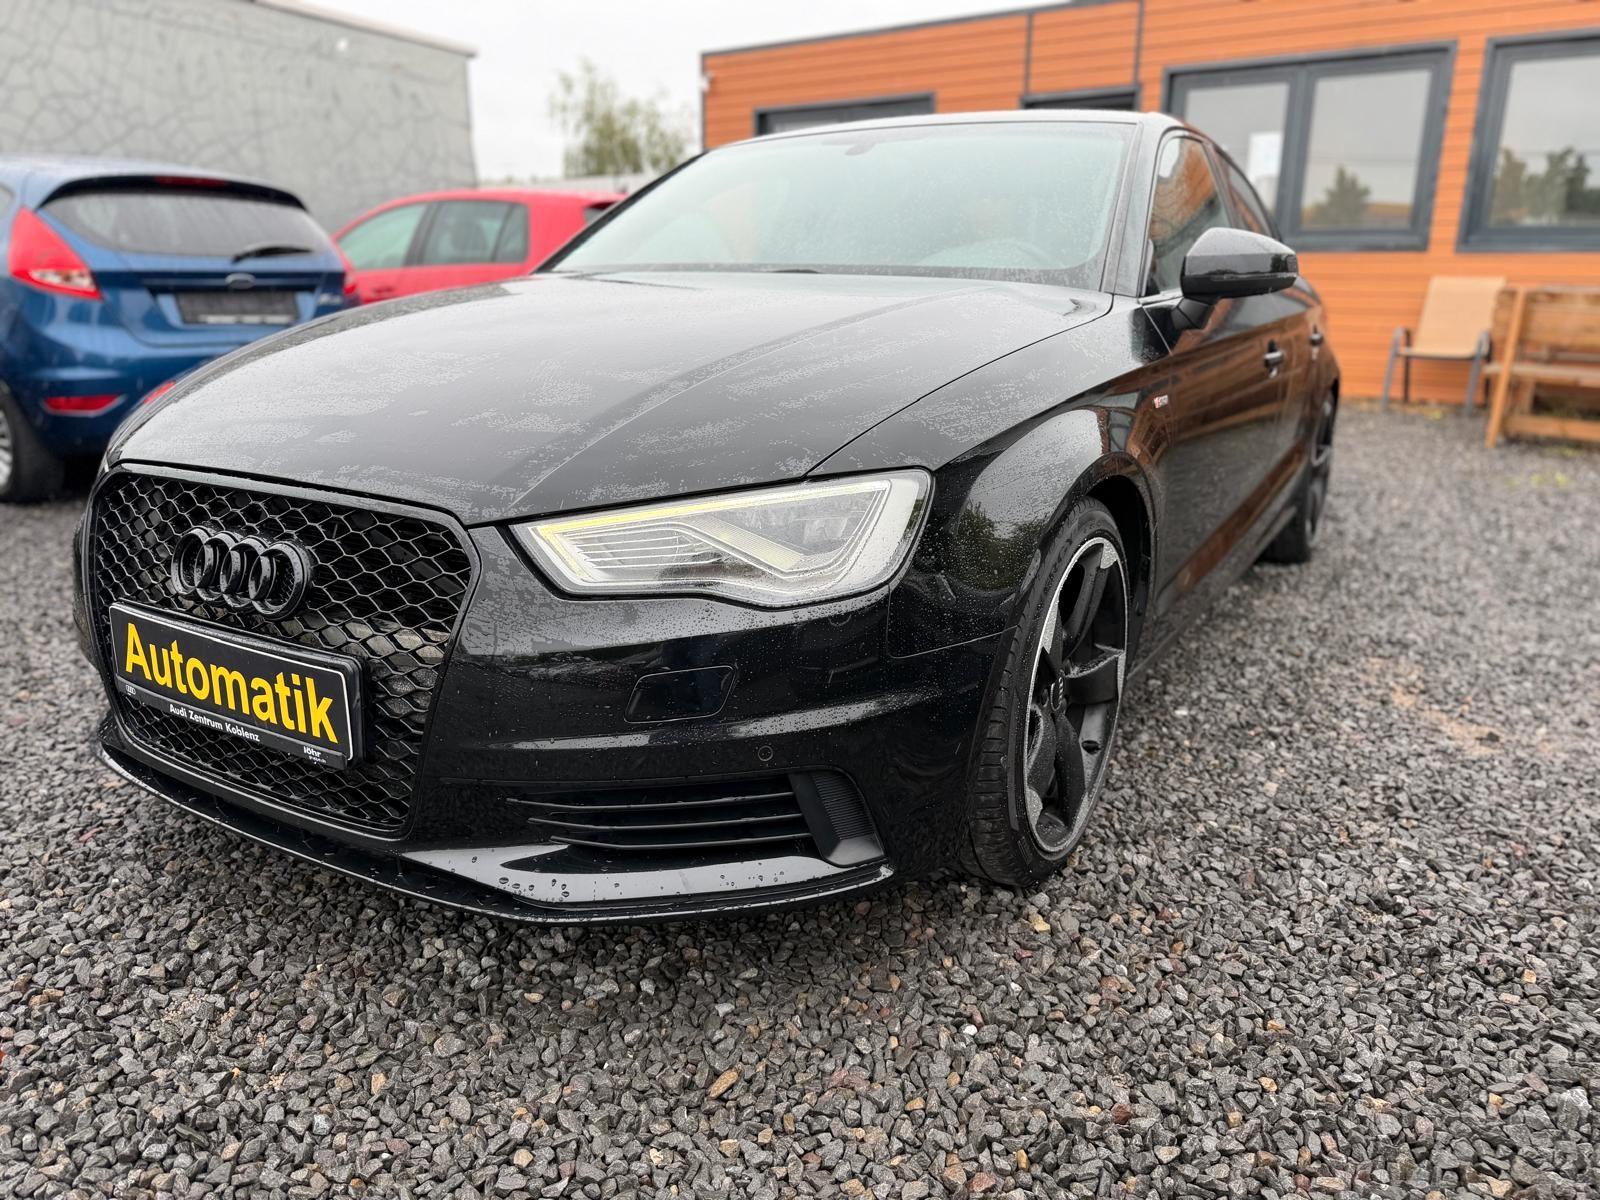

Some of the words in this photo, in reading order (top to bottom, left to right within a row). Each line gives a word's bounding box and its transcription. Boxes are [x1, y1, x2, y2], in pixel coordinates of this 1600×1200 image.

[125, 622, 338, 743] Automatik
[169, 703, 187, 718] Audi
[188, 710, 223, 730] Zentrum
[225, 722, 260, 742] Koblenz
